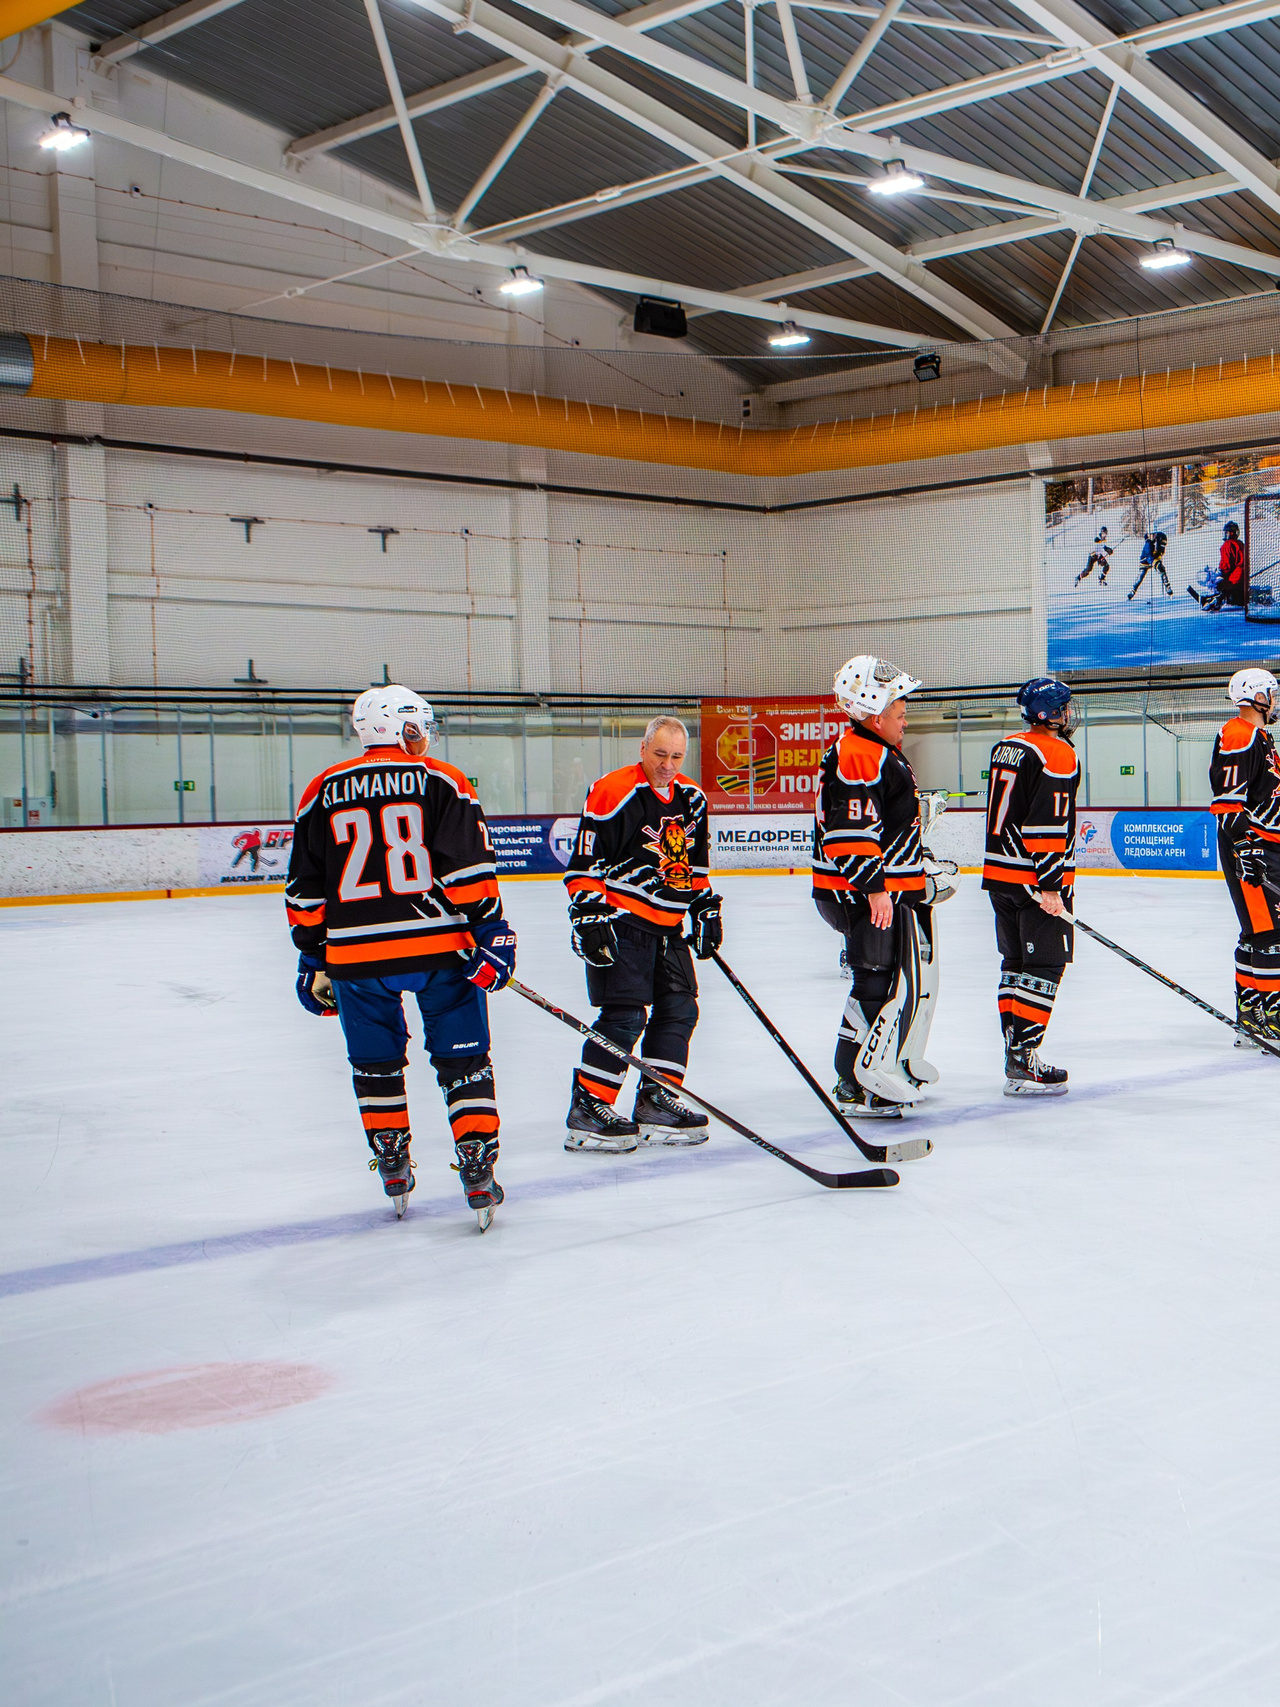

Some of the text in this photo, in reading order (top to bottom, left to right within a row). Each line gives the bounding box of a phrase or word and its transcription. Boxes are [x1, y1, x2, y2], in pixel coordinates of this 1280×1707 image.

[1223, 765, 1239, 788] 71
[322, 770, 428, 809] KLIMANOV
[987, 767, 1017, 835] 17
[848, 798, 878, 822] 94
[1053, 792, 1069, 817] 17
[1124, 824, 1184, 833] КОМПЛЕКСНОЕ
[1124, 836, 1175, 845] ОСНАЩЕНИЕ
[330, 802, 434, 903] 28
[578, 829, 597, 856] 19
[1124, 847, 1186, 858] ЛЕДОВЫХ АРЕН
[572, 914, 610, 926] CCM
[584, 1030, 627, 1060] BAUER
[861, 1014, 887, 1070] CCM
